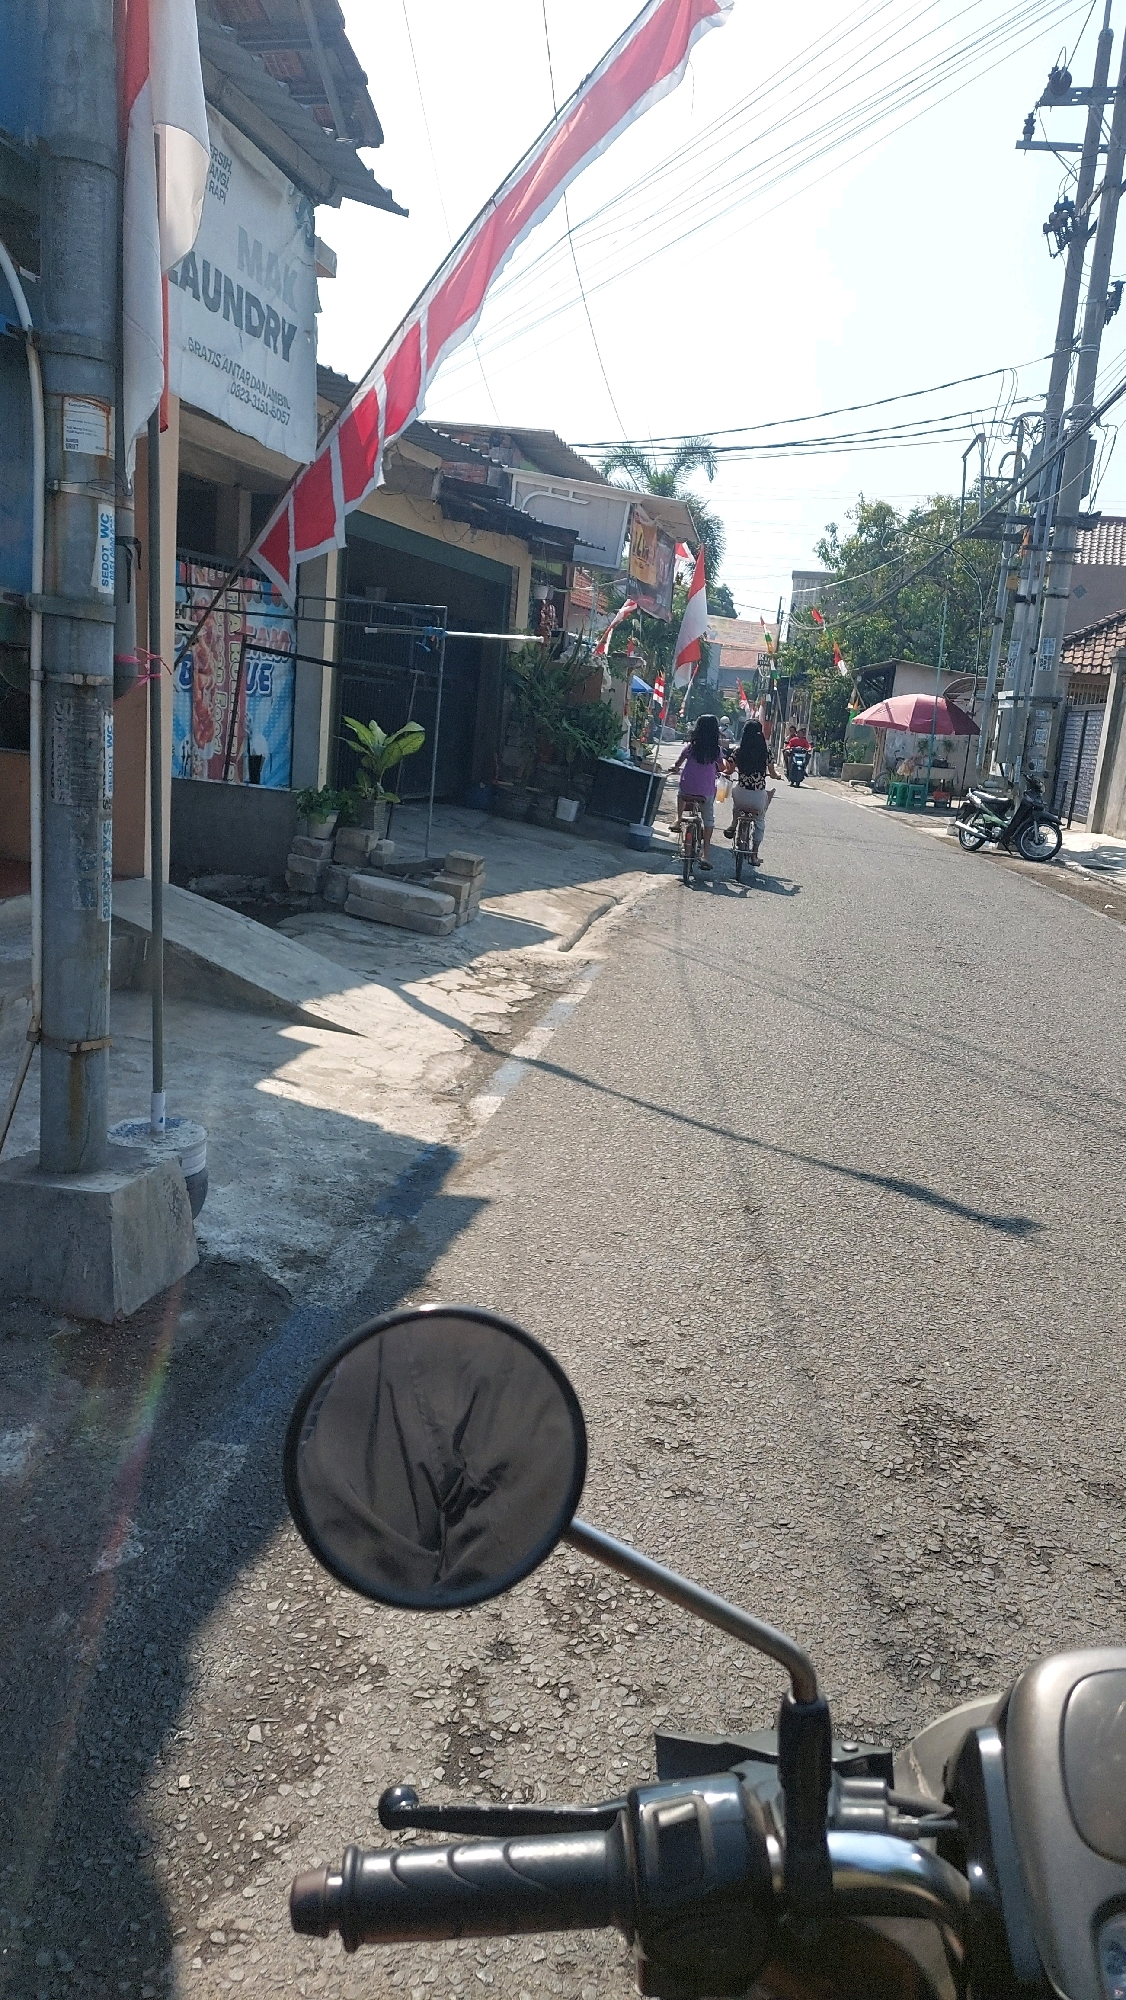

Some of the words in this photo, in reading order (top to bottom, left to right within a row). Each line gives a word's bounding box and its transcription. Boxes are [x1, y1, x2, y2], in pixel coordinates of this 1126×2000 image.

[237, 225, 298, 313] MAK
[187, 336, 222, 368] GRATIS
[221, 358, 251, 386] ANTAR
[249, 374, 269, 397] DAN
[266, 386, 291, 410] AMBIL
[100, 512, 110, 539] WC
[101, 545, 110, 588] SEDOT
[106, 724, 113, 749] WC
